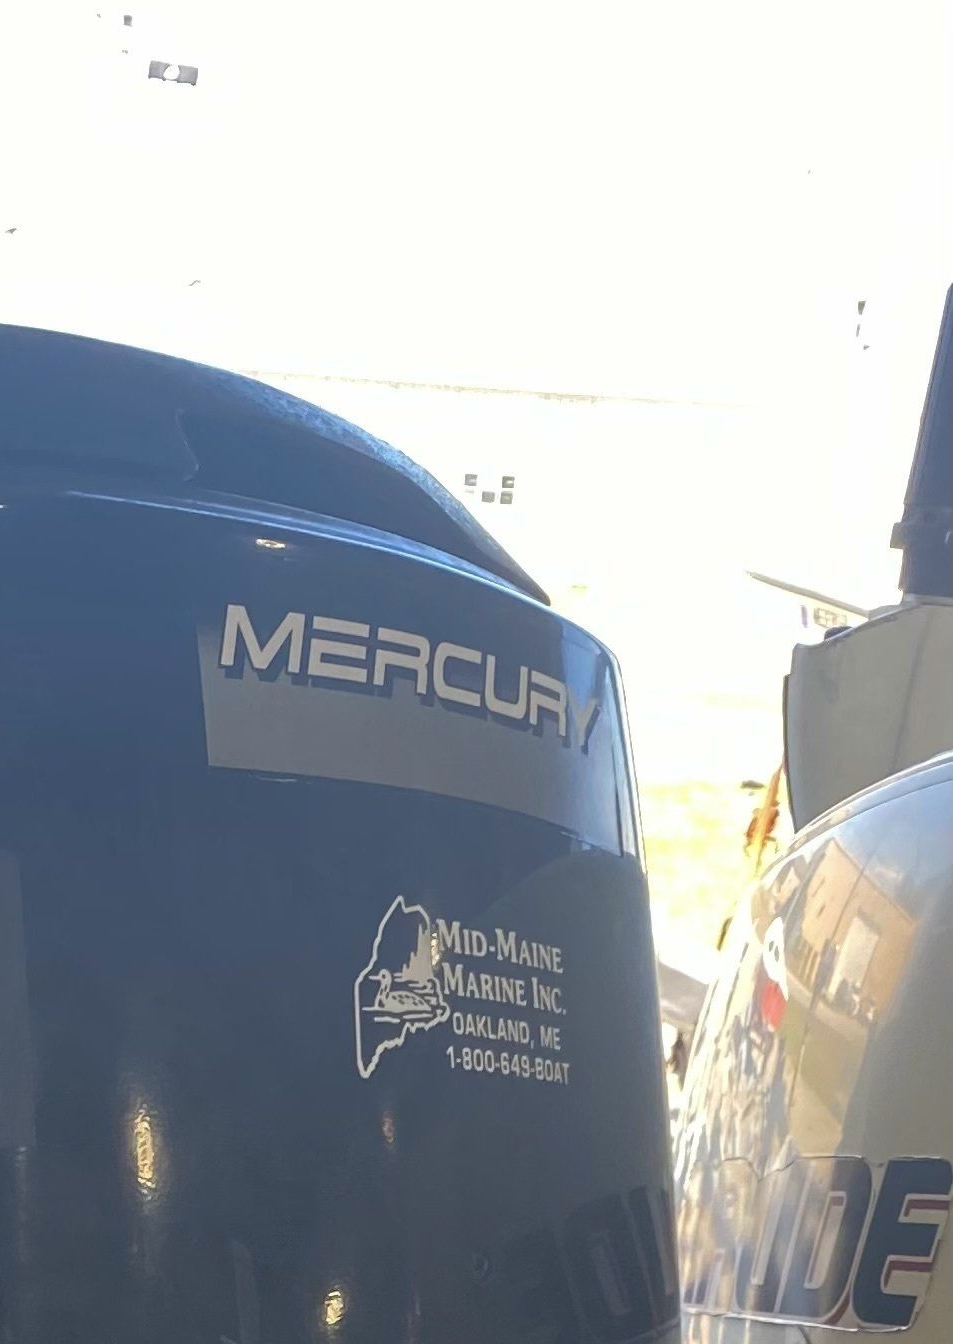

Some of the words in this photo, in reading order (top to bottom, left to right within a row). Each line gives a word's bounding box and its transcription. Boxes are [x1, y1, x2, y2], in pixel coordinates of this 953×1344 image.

[219, 603, 602, 750] MERCURY
[452, 1011, 535, 1049] OAKLAND,
[540, 1025, 561, 1050] ME
[446, 1046, 570, 1085] 1-800-649-BOAT
